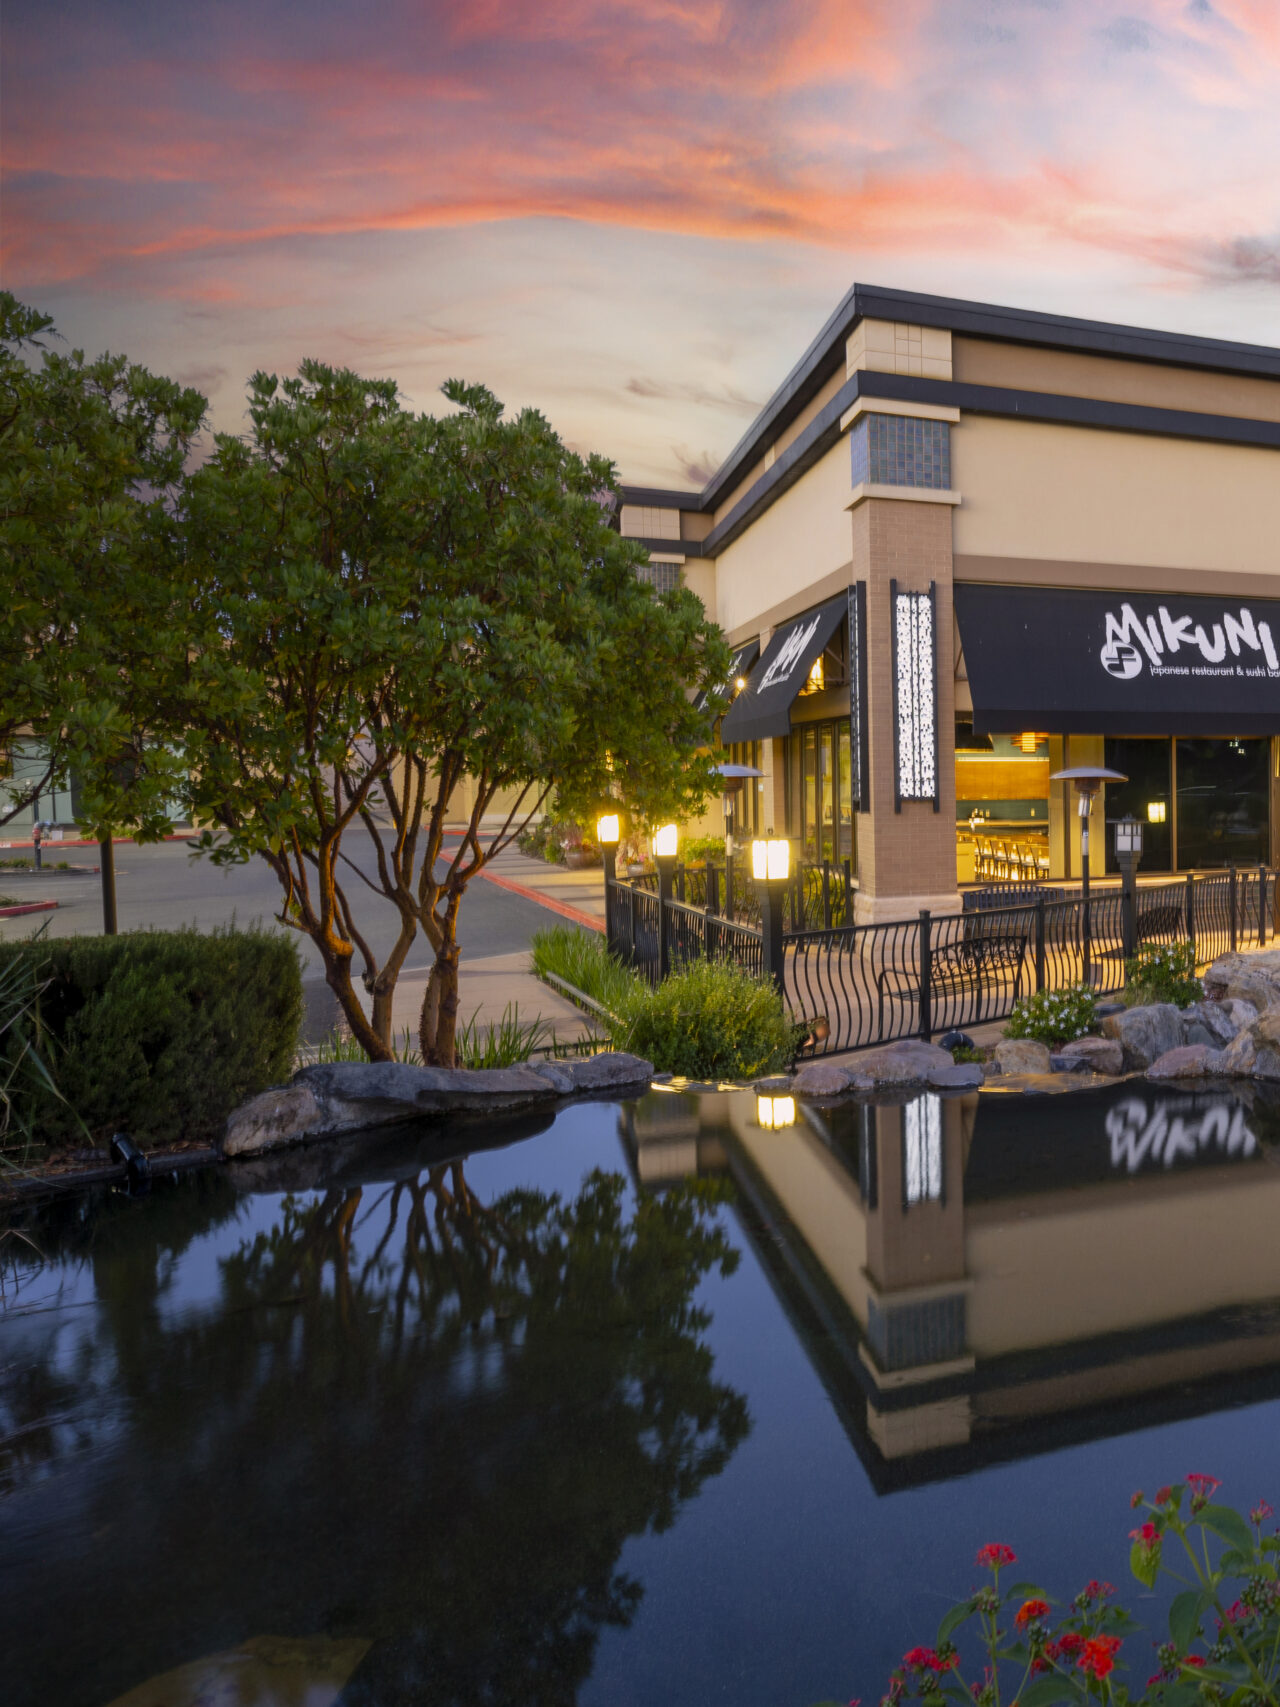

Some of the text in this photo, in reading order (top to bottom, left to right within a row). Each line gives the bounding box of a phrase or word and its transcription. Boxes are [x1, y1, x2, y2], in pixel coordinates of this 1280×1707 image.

[1102, 603, 1279, 669] MIKUNI
[1149, 664, 1189, 677] japanese
[1191, 664, 1234, 676] restaurant
[1246, 665, 1266, 677] sushi
